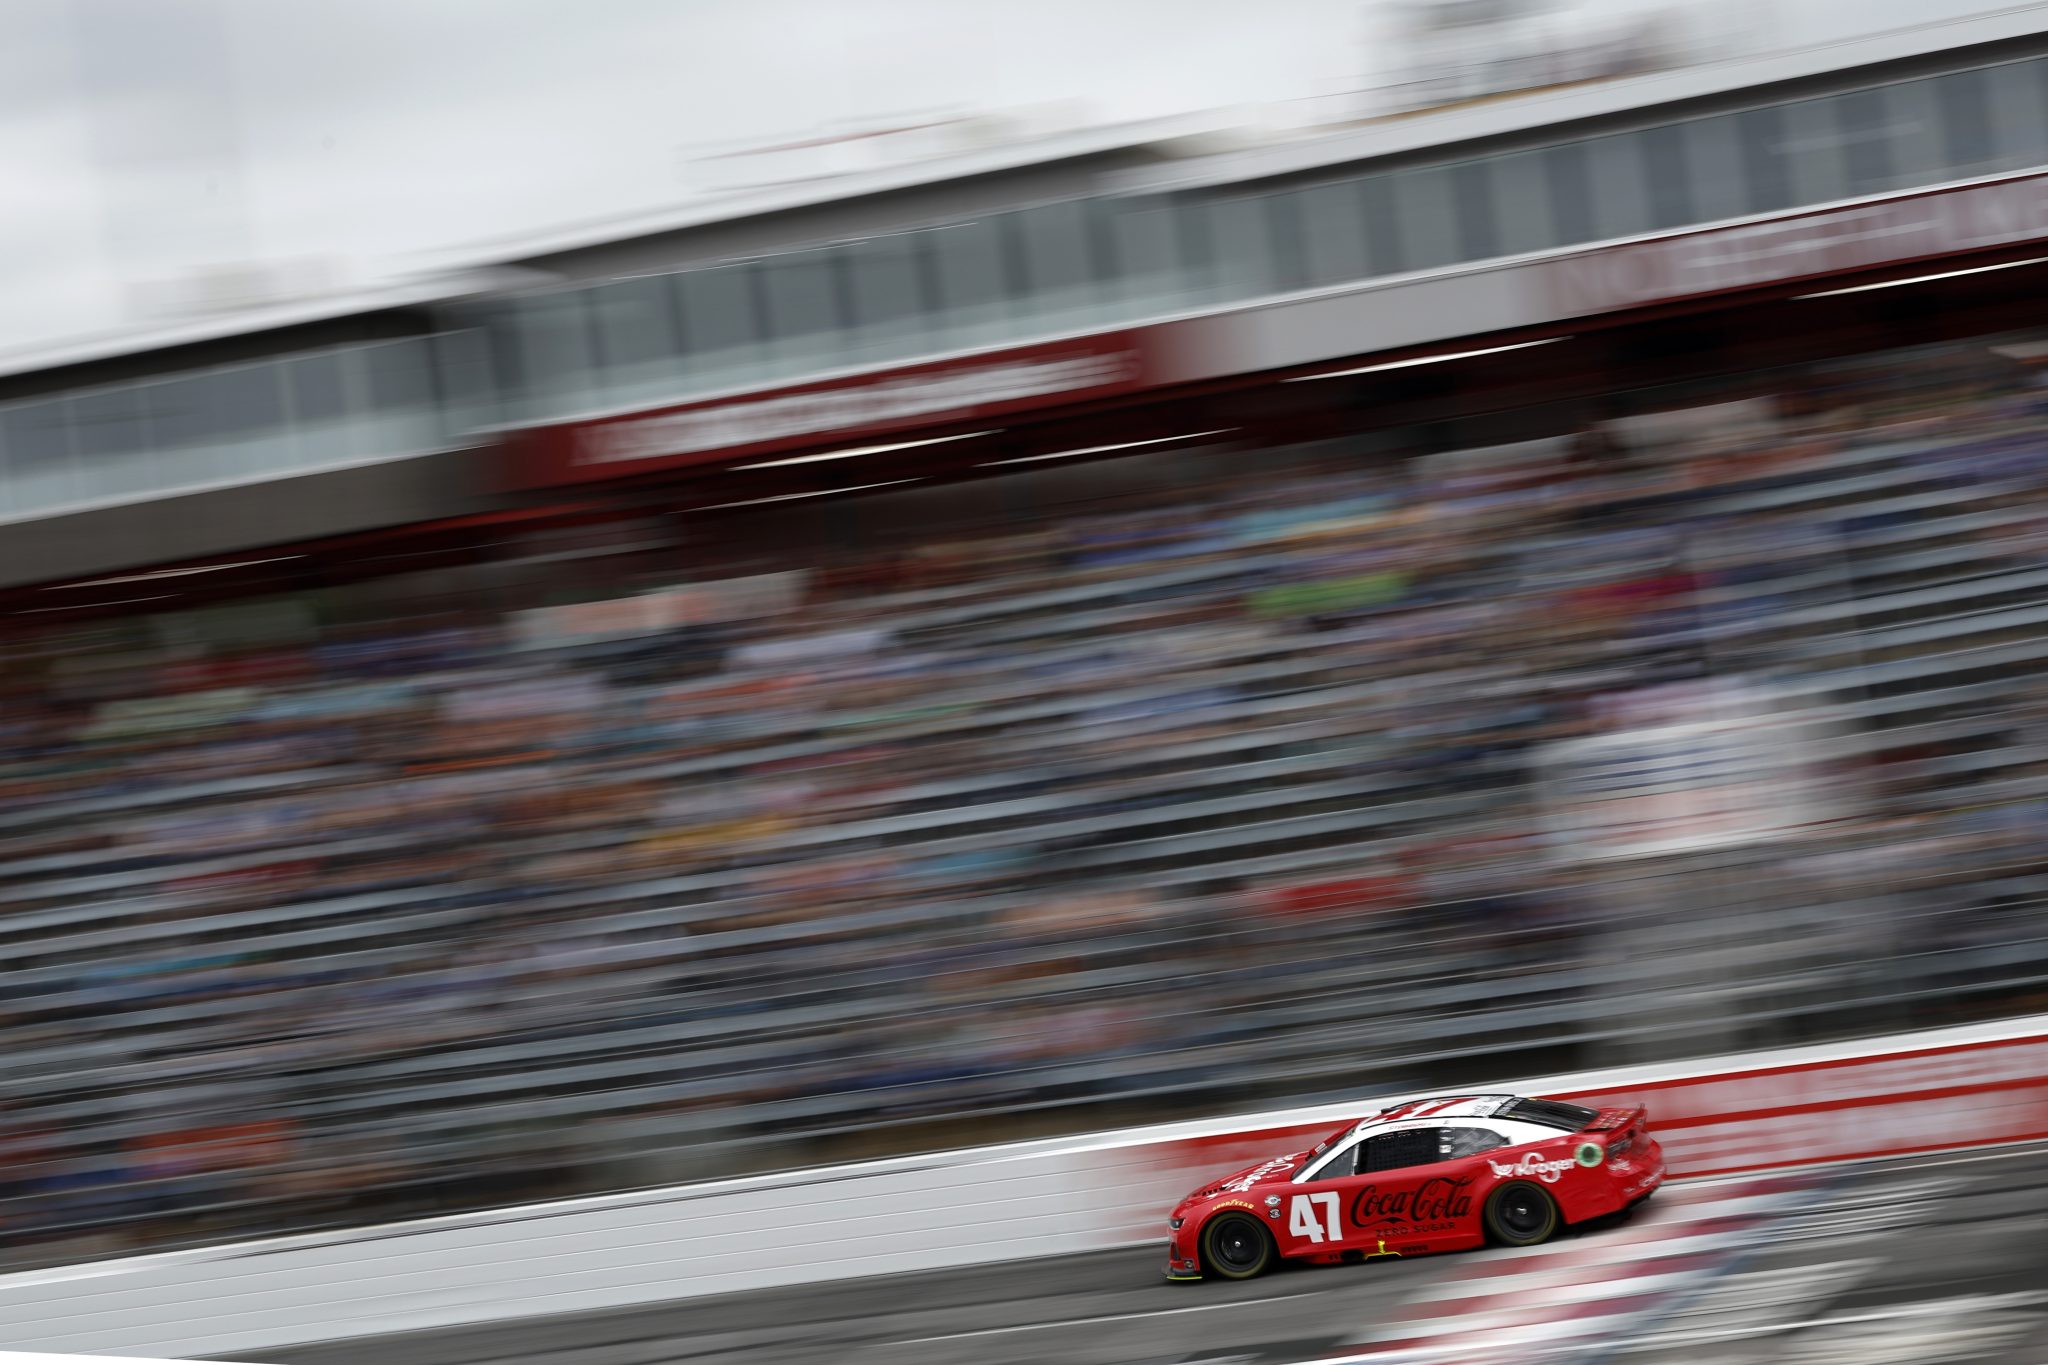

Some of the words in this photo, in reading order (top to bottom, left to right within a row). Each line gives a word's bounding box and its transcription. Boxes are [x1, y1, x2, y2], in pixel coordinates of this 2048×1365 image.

[1513, 1152, 1577, 1183] Kroger
[1289, 1191, 1343, 1243] 47
[1350, 1175, 1478, 1228] Coca-Cola
[1375, 1226, 1409, 1238] ZERO
[1413, 1222, 1456, 1232] SUGAR
